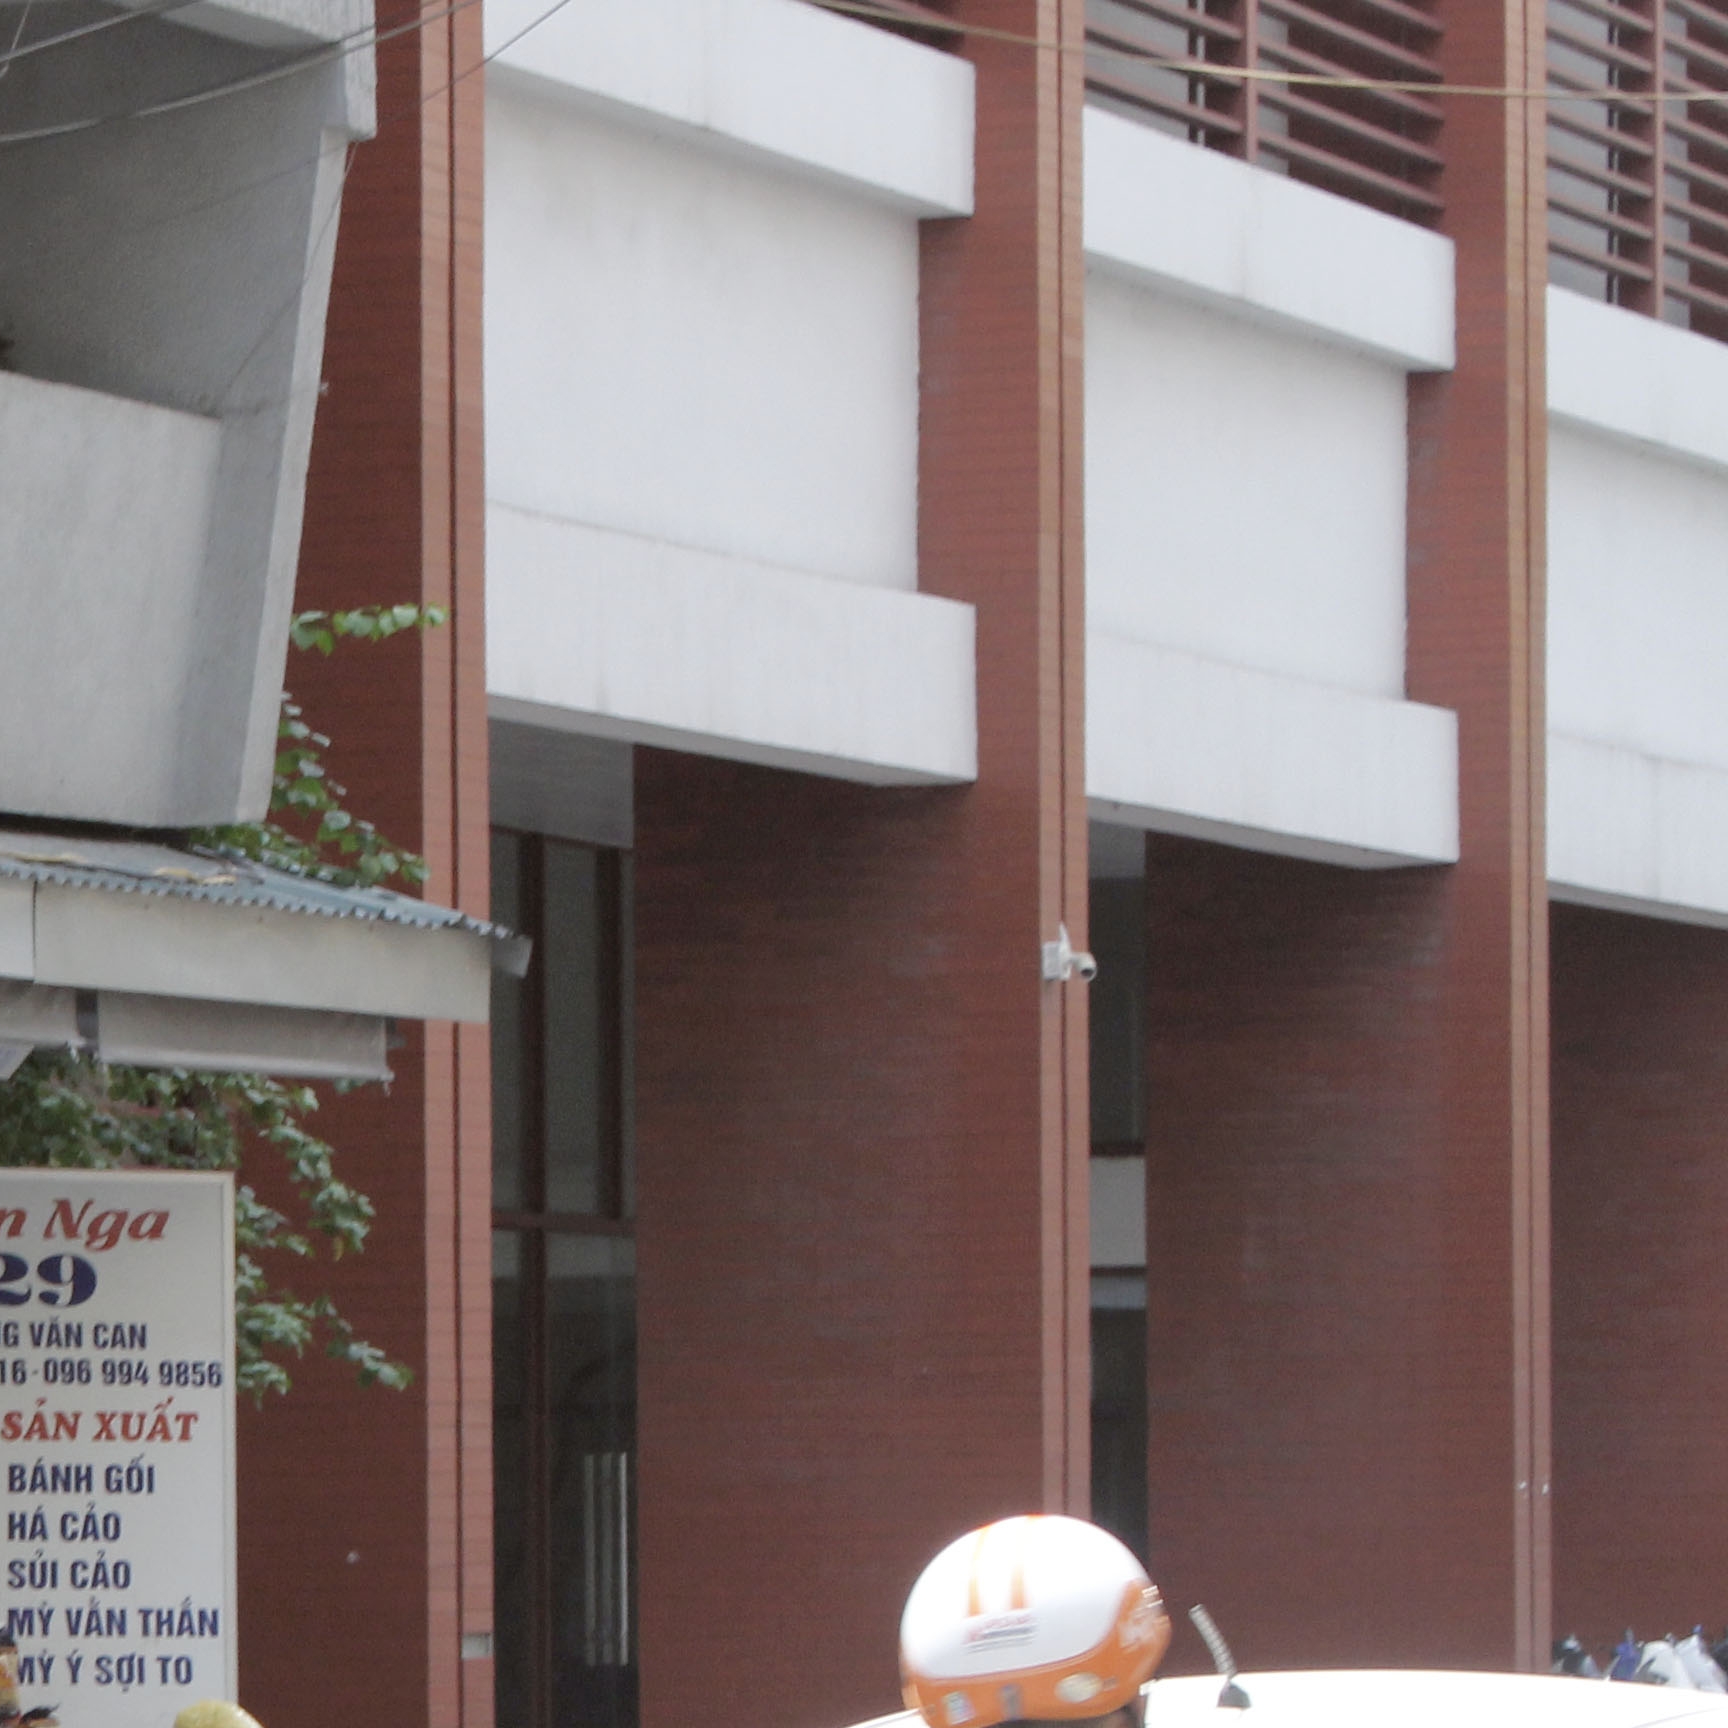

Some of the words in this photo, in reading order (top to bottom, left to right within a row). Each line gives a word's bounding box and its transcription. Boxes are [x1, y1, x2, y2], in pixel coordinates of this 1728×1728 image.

[43, 1198, 171, 1253] Nga
[28, 1316, 84, 1350] VĂN
[93, 1322, 148, 1351] CAN
[43, 1358, 92, 1387] 096
[100, 1358, 150, 1388] 994
[158, 1359, 224, 1389] 9856
[0, 1397, 83, 1442] SẢN
[91, 1395, 199, 1444] XUẤT
[7, 1455, 93, 1495] BÁNH
[104, 1453, 156, 1495] GỐI
[7, 1505, 49, 1542] HÁ
[59, 1501, 122, 1542] CẢO
[7, 1549, 59, 1590] SỦI
[69, 1548, 132, 1590] CẢO
[137, 1596, 220, 1638] THẮN
[94, 1652, 145, 1697] SỢI
[155, 1654, 193, 1685] TO
